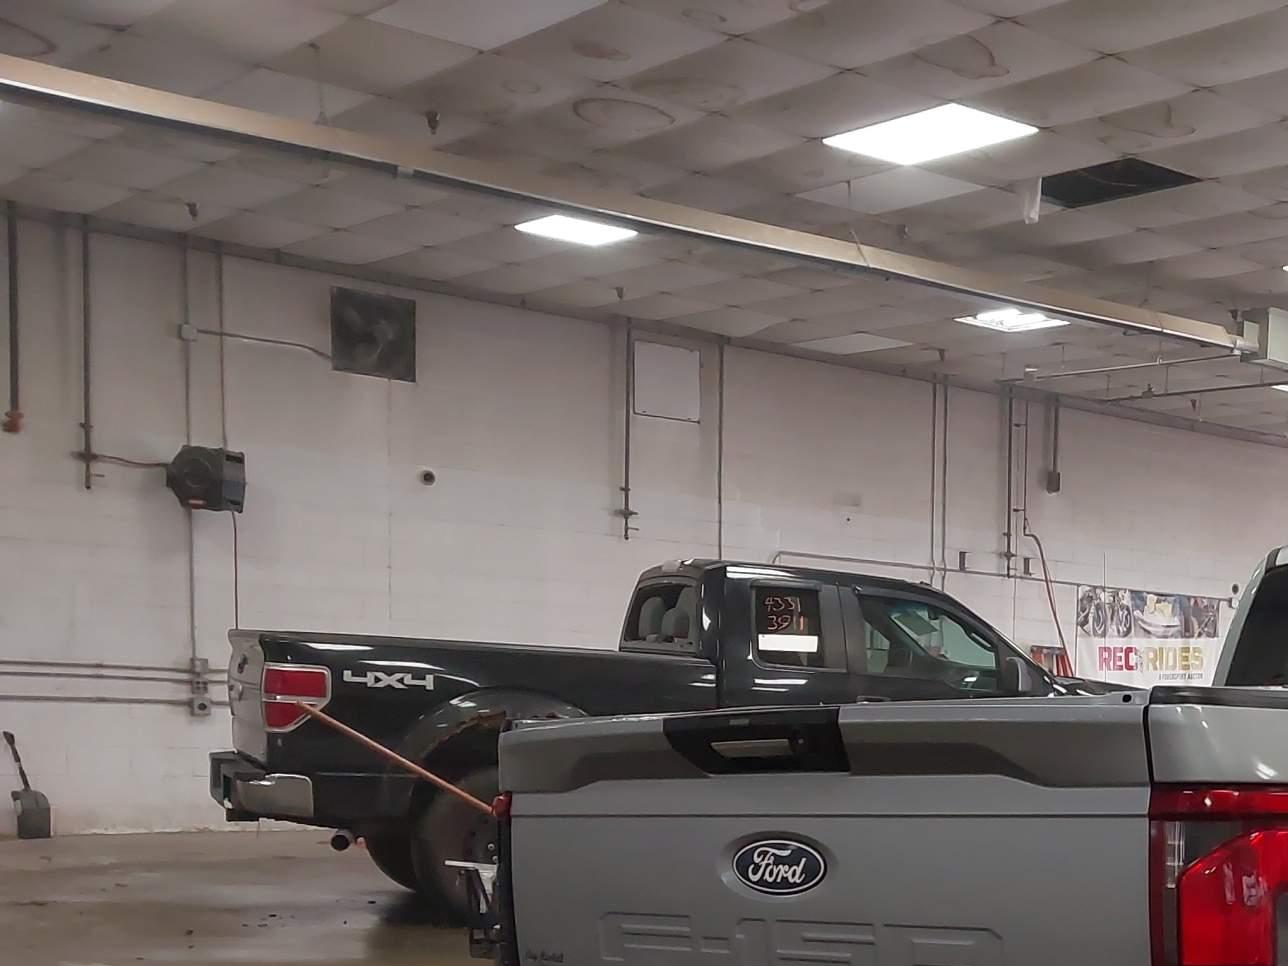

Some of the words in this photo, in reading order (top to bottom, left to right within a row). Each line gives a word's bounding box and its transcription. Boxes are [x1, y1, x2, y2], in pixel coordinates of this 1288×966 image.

[764, 596, 801, 613] 4331
[1098, 646, 1135, 671] REC
[1147, 646, 1204, 672] RIDES
[747, 846, 807, 885] Ford
